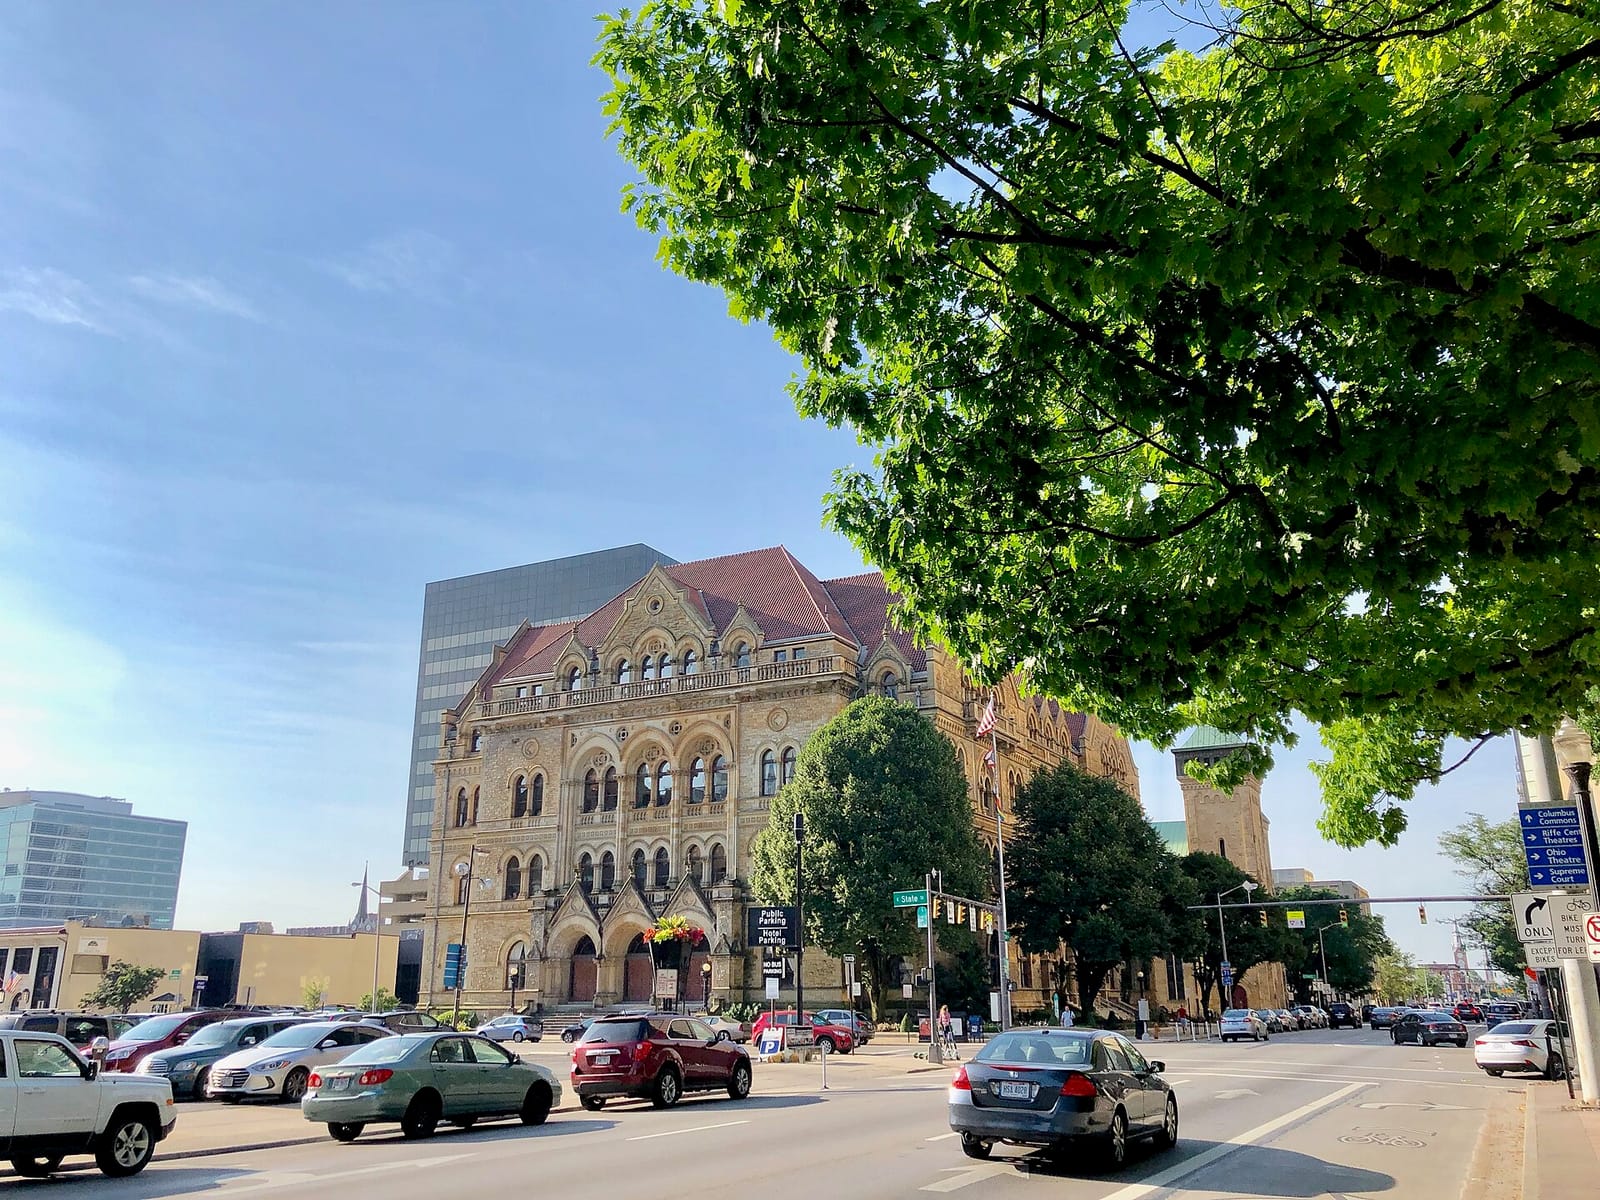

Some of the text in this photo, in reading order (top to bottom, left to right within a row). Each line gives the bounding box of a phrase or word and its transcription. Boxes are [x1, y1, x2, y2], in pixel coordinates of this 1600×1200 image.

[1538, 809, 1575, 818] Columbus
[1542, 829, 1561, 837] Riffe
[1543, 836, 1578, 845] Theatres
[1546, 848, 1567, 857] Ohio
[1547, 856, 1581, 865] Theatre
[1549, 868, 1586, 877] Supreme
[1551, 875, 1575, 883] Court
[901, 895, 918, 903] State
[761, 909, 784, 918] Public
[1561, 914, 1579, 922] BIKE
[758, 917, 787, 926] Parking
[762, 929, 782, 937] Hotel
[1524, 926, 1553, 937] ONLY
[758, 936, 786, 946] Parking
[1566, 936, 1586, 944] TURN
[1558, 946, 1573, 955] FOR
[1535, 955, 1556, 963] BIKES
[764, 1041, 775, 1054] P
